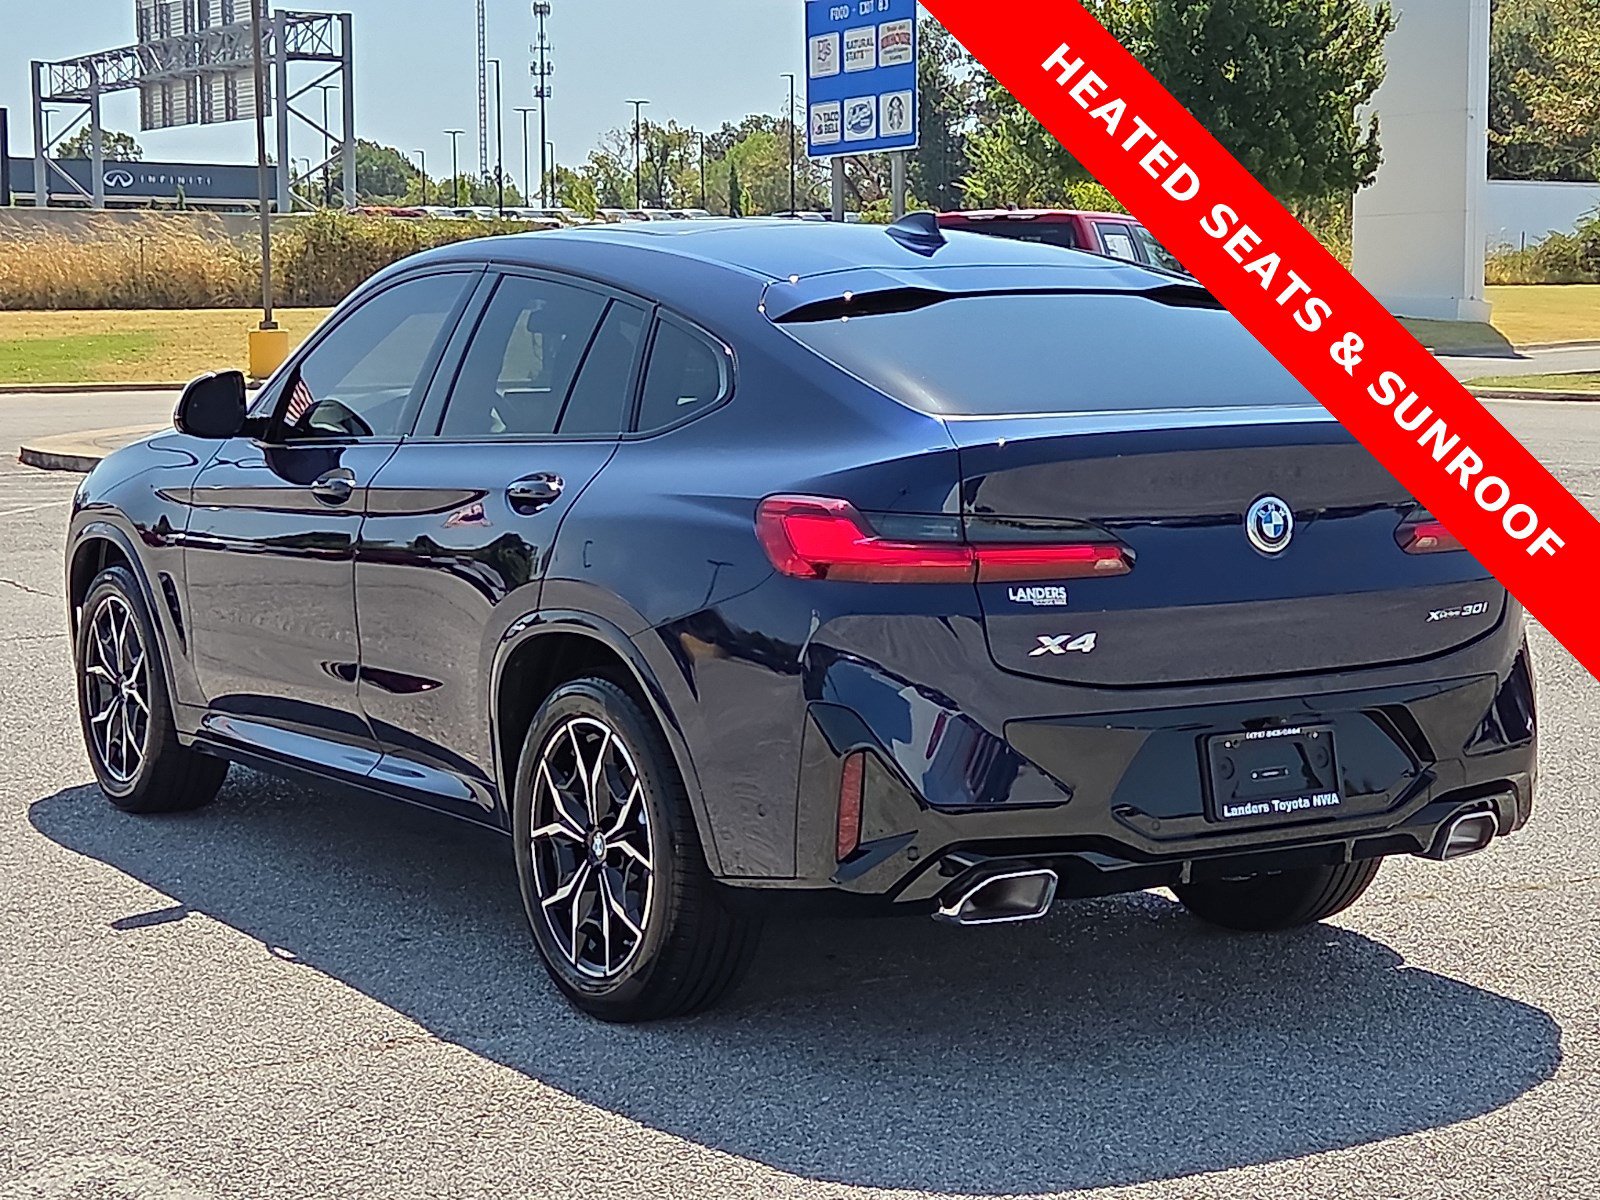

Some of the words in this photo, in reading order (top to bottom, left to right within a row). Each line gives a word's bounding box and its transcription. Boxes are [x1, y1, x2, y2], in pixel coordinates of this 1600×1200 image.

[823, 111, 839, 122] TACO
[824, 123, 839, 134] BELL
[140, 175, 211, 186] INFINITI
[1008, 586, 1067, 602] LANDERS
[1028, 632, 1097, 656] X4
[1223, 802, 1270, 818] Landers
[1271, 798, 1310, 813] Toyota
[1312, 793, 1340, 806] NWA
